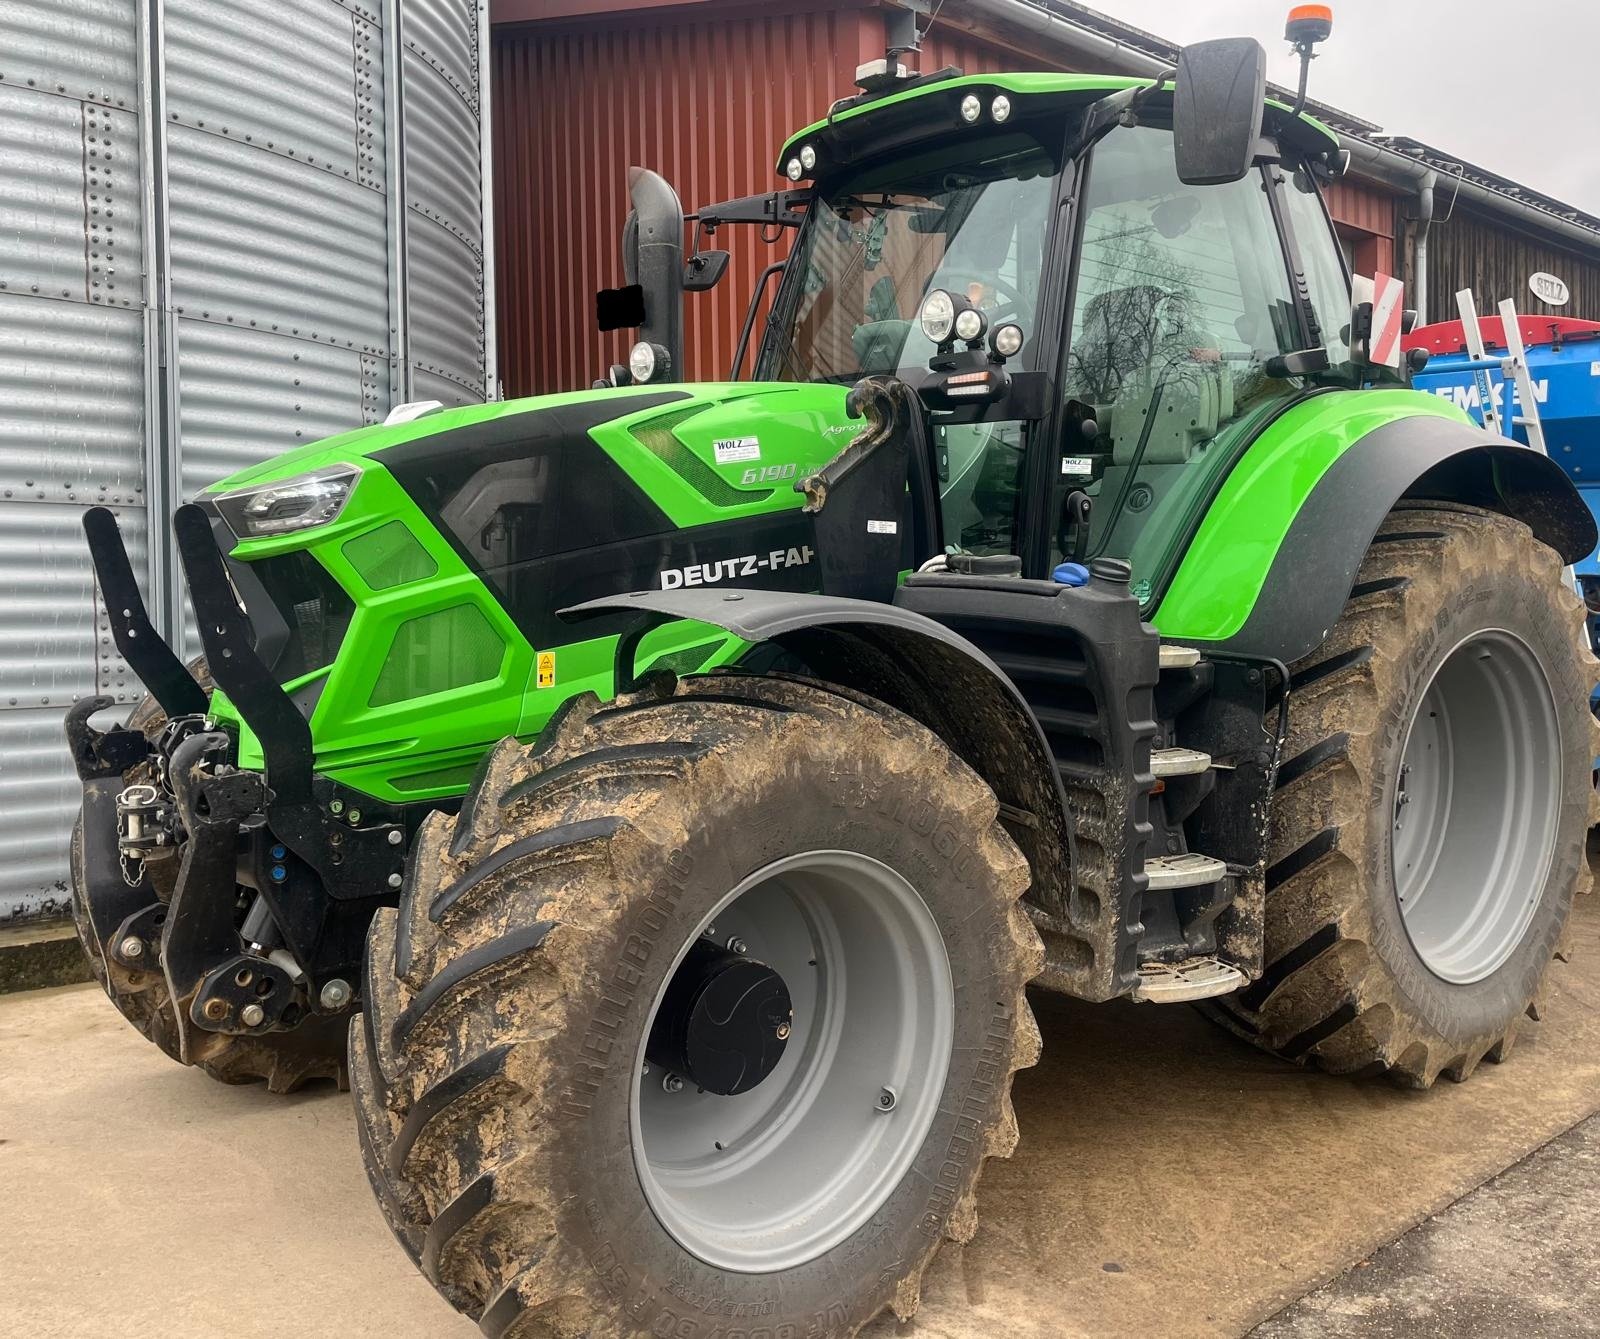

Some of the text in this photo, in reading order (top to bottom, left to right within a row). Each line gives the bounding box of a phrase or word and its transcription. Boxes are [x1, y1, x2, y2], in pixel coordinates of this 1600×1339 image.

[1421, 379, 1549, 412] EMKEN
[717, 439, 743, 450] WOLZ
[741, 463, 797, 485] 6190
[660, 545, 815, 590] DEUTZ-FAH
[561, 847, 694, 1124] TRELLEBORG
[917, 1009, 1012, 1240] TRELLEBORG
